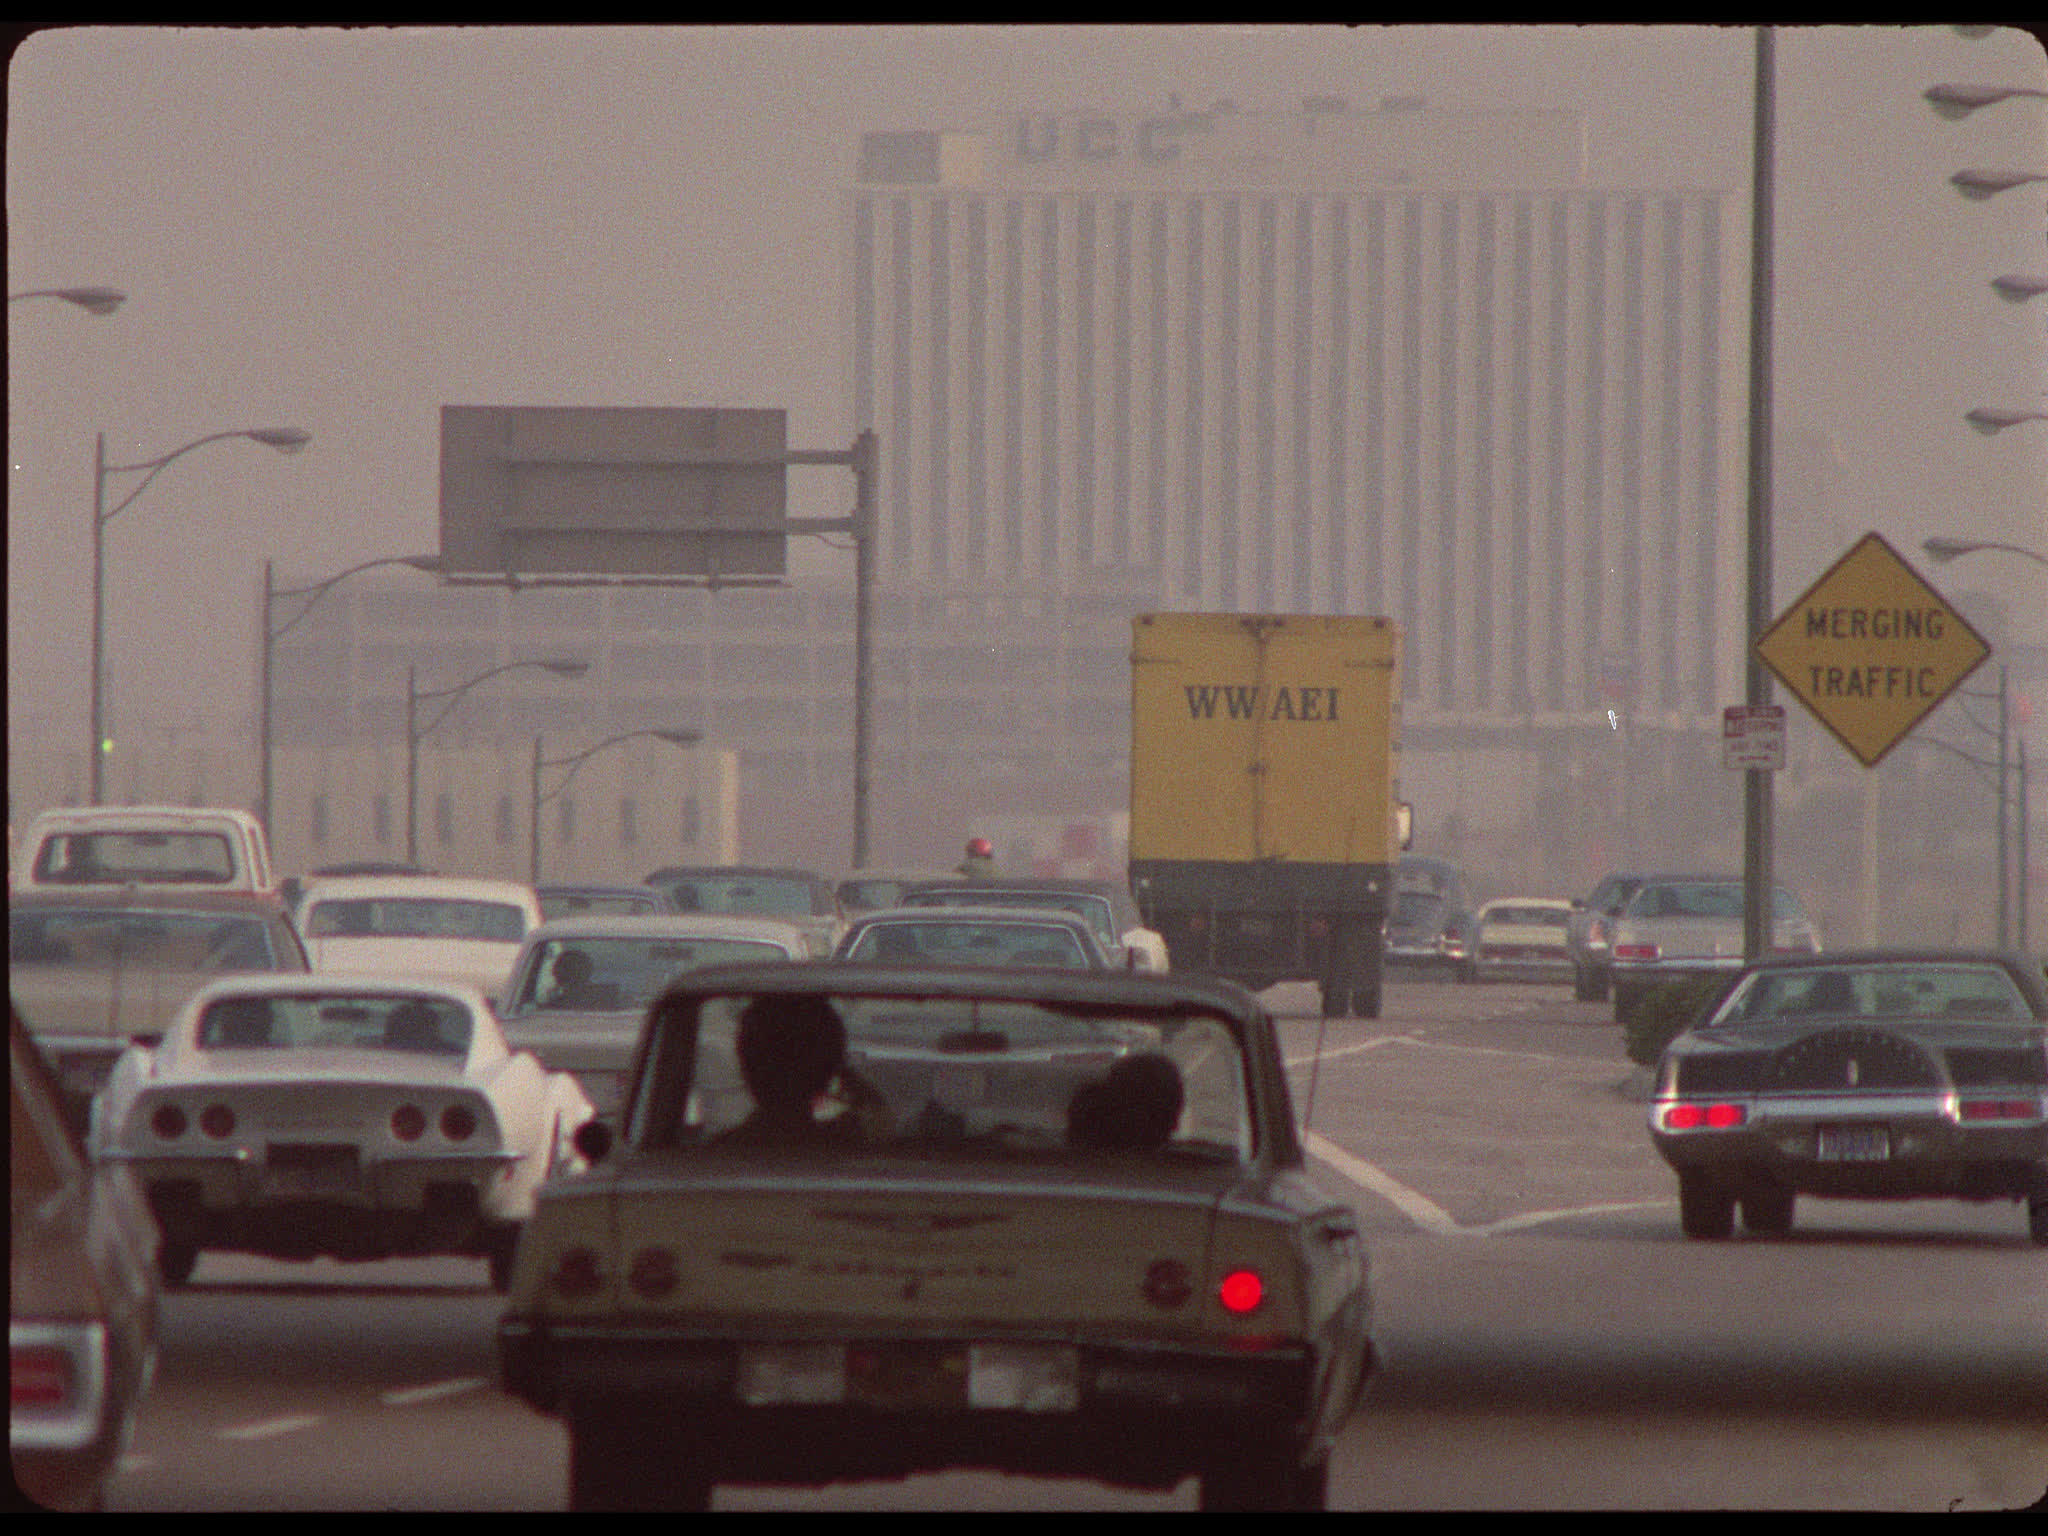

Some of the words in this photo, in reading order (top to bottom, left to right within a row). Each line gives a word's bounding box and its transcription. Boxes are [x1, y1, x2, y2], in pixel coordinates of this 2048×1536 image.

[1016, 117, 1181, 163] UCC
[1806, 608, 1945, 641] MERGING
[1809, 664, 1936, 698] TRAFFIC
